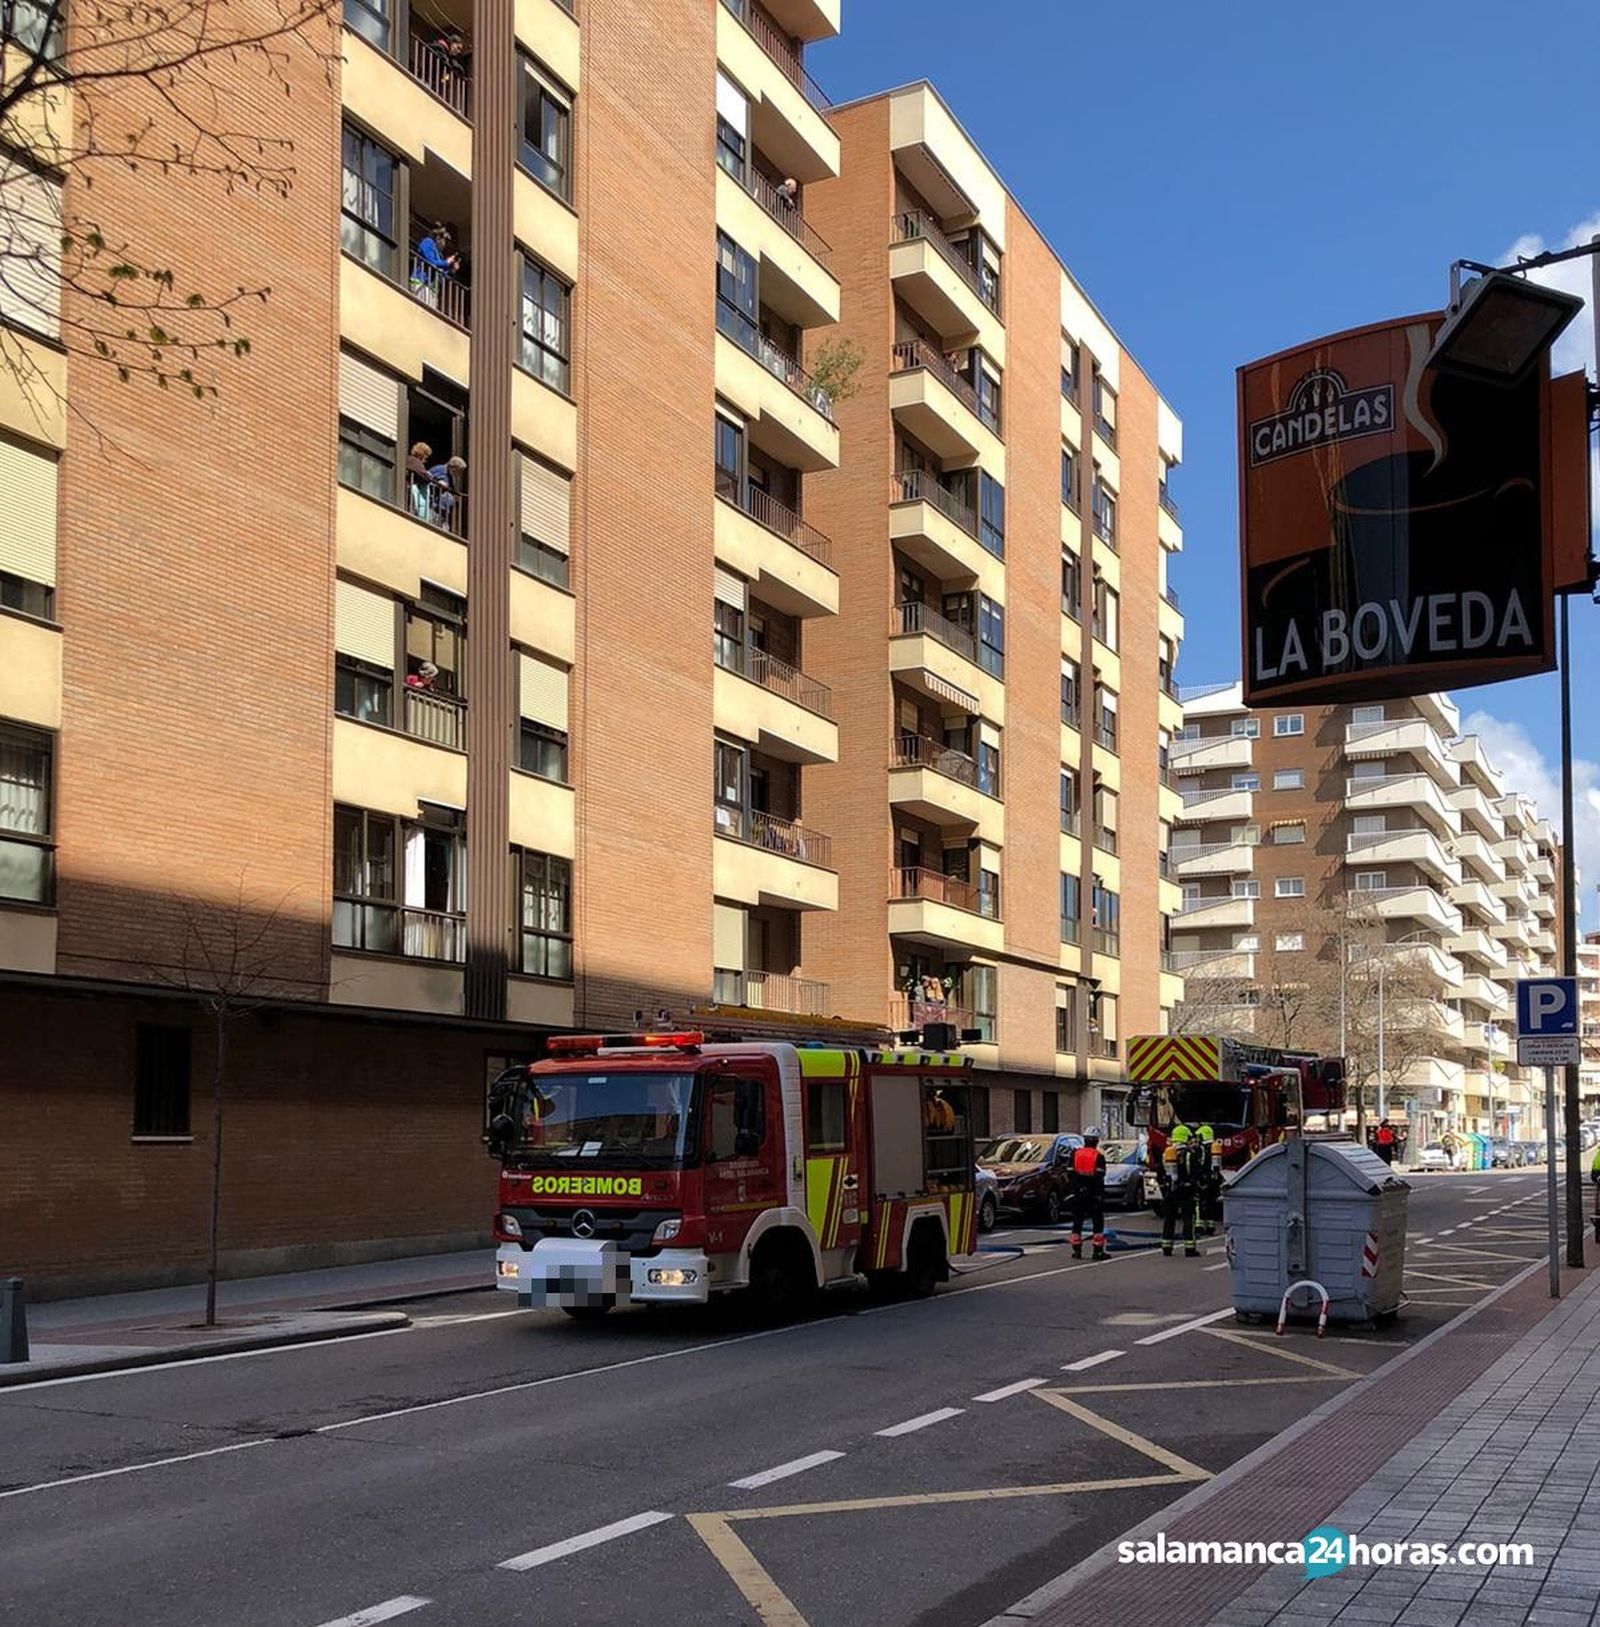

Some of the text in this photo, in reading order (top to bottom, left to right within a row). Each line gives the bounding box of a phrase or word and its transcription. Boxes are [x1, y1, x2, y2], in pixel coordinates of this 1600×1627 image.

[1255, 394, 1388, 456] CANDELAS
[1255, 586, 1535, 682] LA BOVEDA
[1529, 984, 1566, 1029] P
